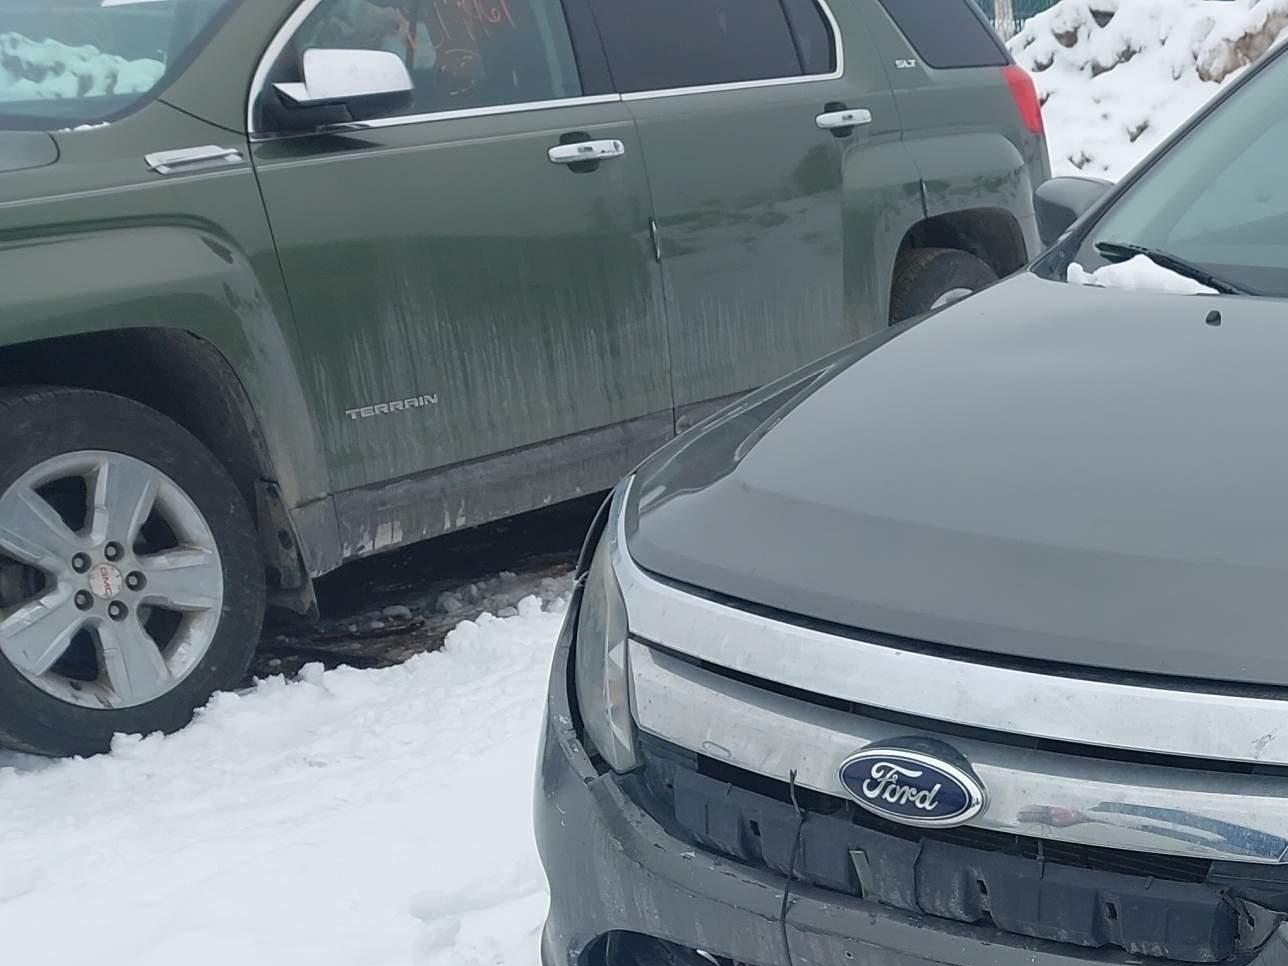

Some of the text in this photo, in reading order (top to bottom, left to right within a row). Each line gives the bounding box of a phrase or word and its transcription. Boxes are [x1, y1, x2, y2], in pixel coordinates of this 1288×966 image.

[895, 59, 916, 68] SLT
[345, 393, 438, 420] TERRAIN
[100, 566, 113, 599] GMC
[862, 761, 942, 811] Ford
